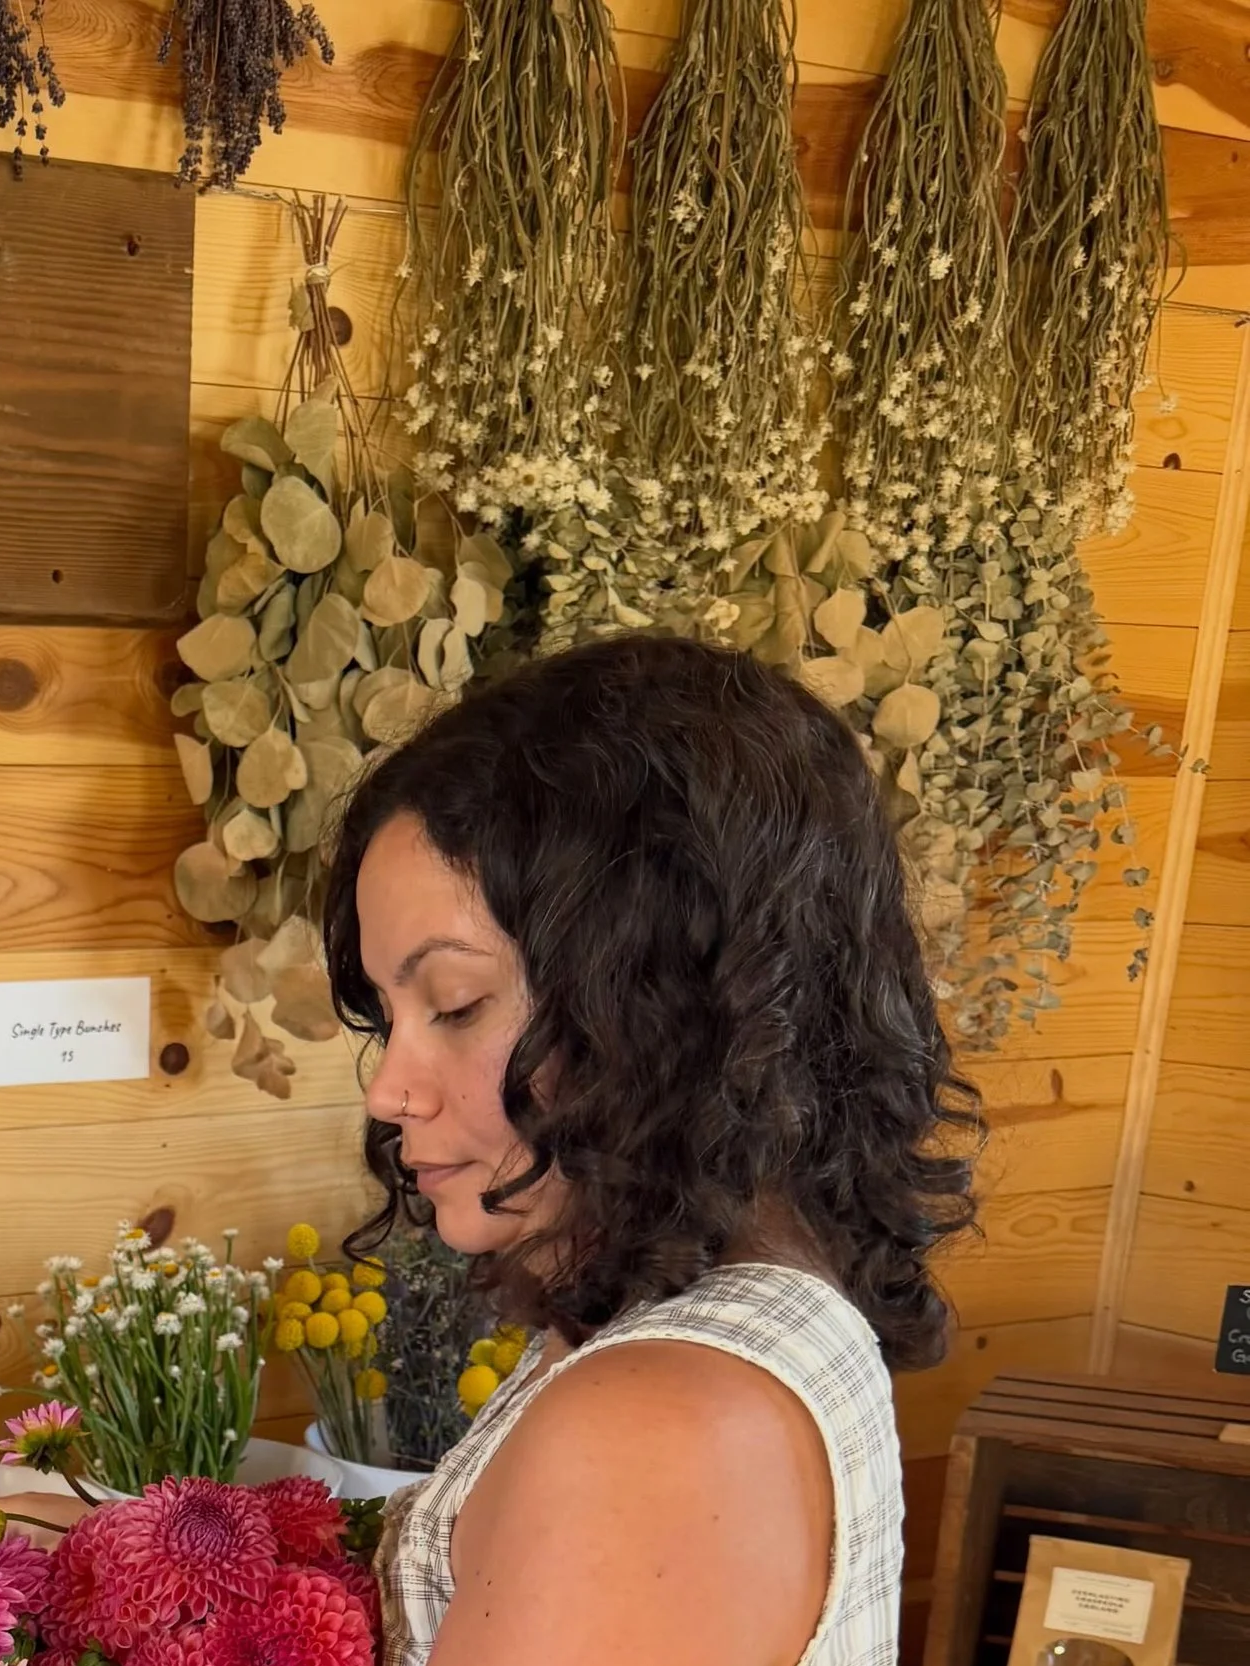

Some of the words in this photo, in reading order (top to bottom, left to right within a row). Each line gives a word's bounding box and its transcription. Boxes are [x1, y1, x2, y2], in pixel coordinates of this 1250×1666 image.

[11, 1022, 45, 1041] Single
[49, 1021, 73, 1041] Type
[76, 1019, 122, 1036] Bunches
